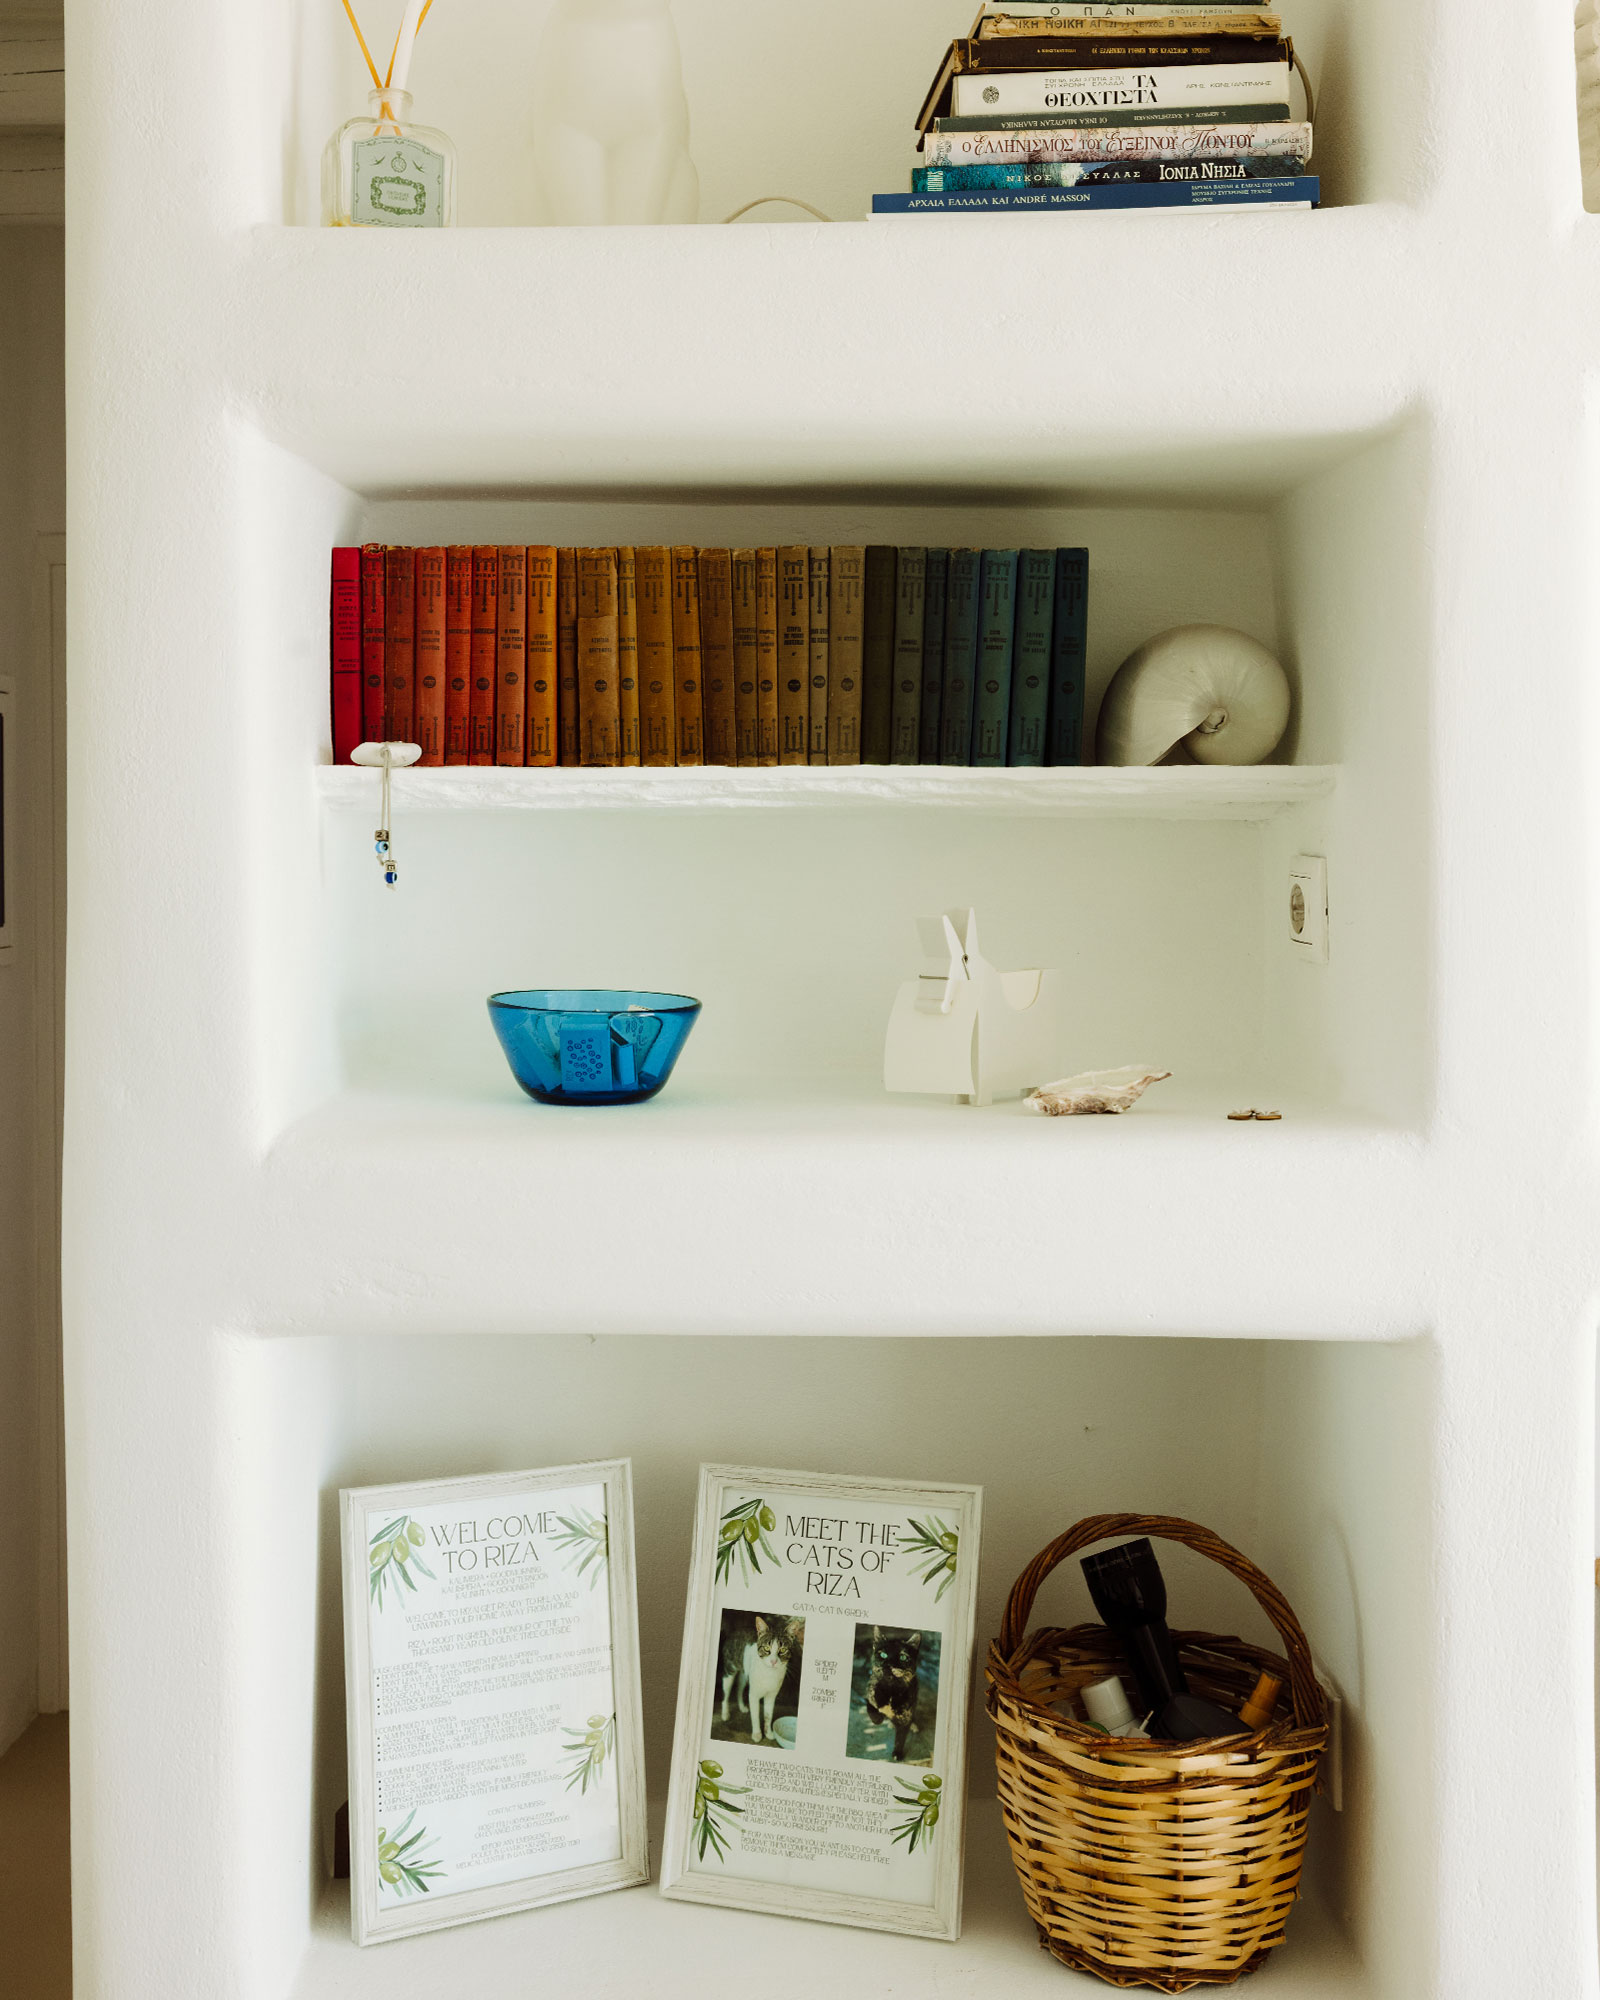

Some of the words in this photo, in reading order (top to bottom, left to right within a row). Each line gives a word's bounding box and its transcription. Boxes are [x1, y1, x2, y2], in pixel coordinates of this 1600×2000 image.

[1132, 74, 1158, 88] ΤΑ
[1044, 89, 1158, 108] ΘΕΟΧΤΙΣΤΑ
[962, 141, 972, 153] Ο
[974, 134, 1074, 156] ΕΛΛΗΝΙΣΜΟΣ
[1078, 137, 1103, 150] ΤΟΥ
[1105, 131, 1178, 153] ΕΥΞΕΙΝΟΥ
[1181, 127, 1255, 151] ΠΟΝΤΟΥ
[1006, 174, 1052, 182] ΝΙΚΟΣ
[1159, 164, 1199, 180] ΙΟΝΙΑ
[1200, 162, 1247, 179] ΝΗΣΙΑ
[908, 199, 945, 208] ΑΡΧΑΙΑ
[948, 198, 989, 207] ΕΛΛΑΔΑ
[992, 197, 1009, 205] ΚΑΙ
[1012, 194, 1048, 204] ANDRÉ
[1051, 193, 1091, 203] MASSON
[430, 1511, 557, 1547] WELCOME
[785, 1515, 848, 1542] MEET
[855, 1522, 901, 1547] THE
[443, 1548, 478, 1573] TO
[485, 1540, 539, 1568] RIZA
[786, 1542, 854, 1570] CATS
[860, 1549, 895, 1574] OF
[807, 1572, 862, 1598] RIZA
